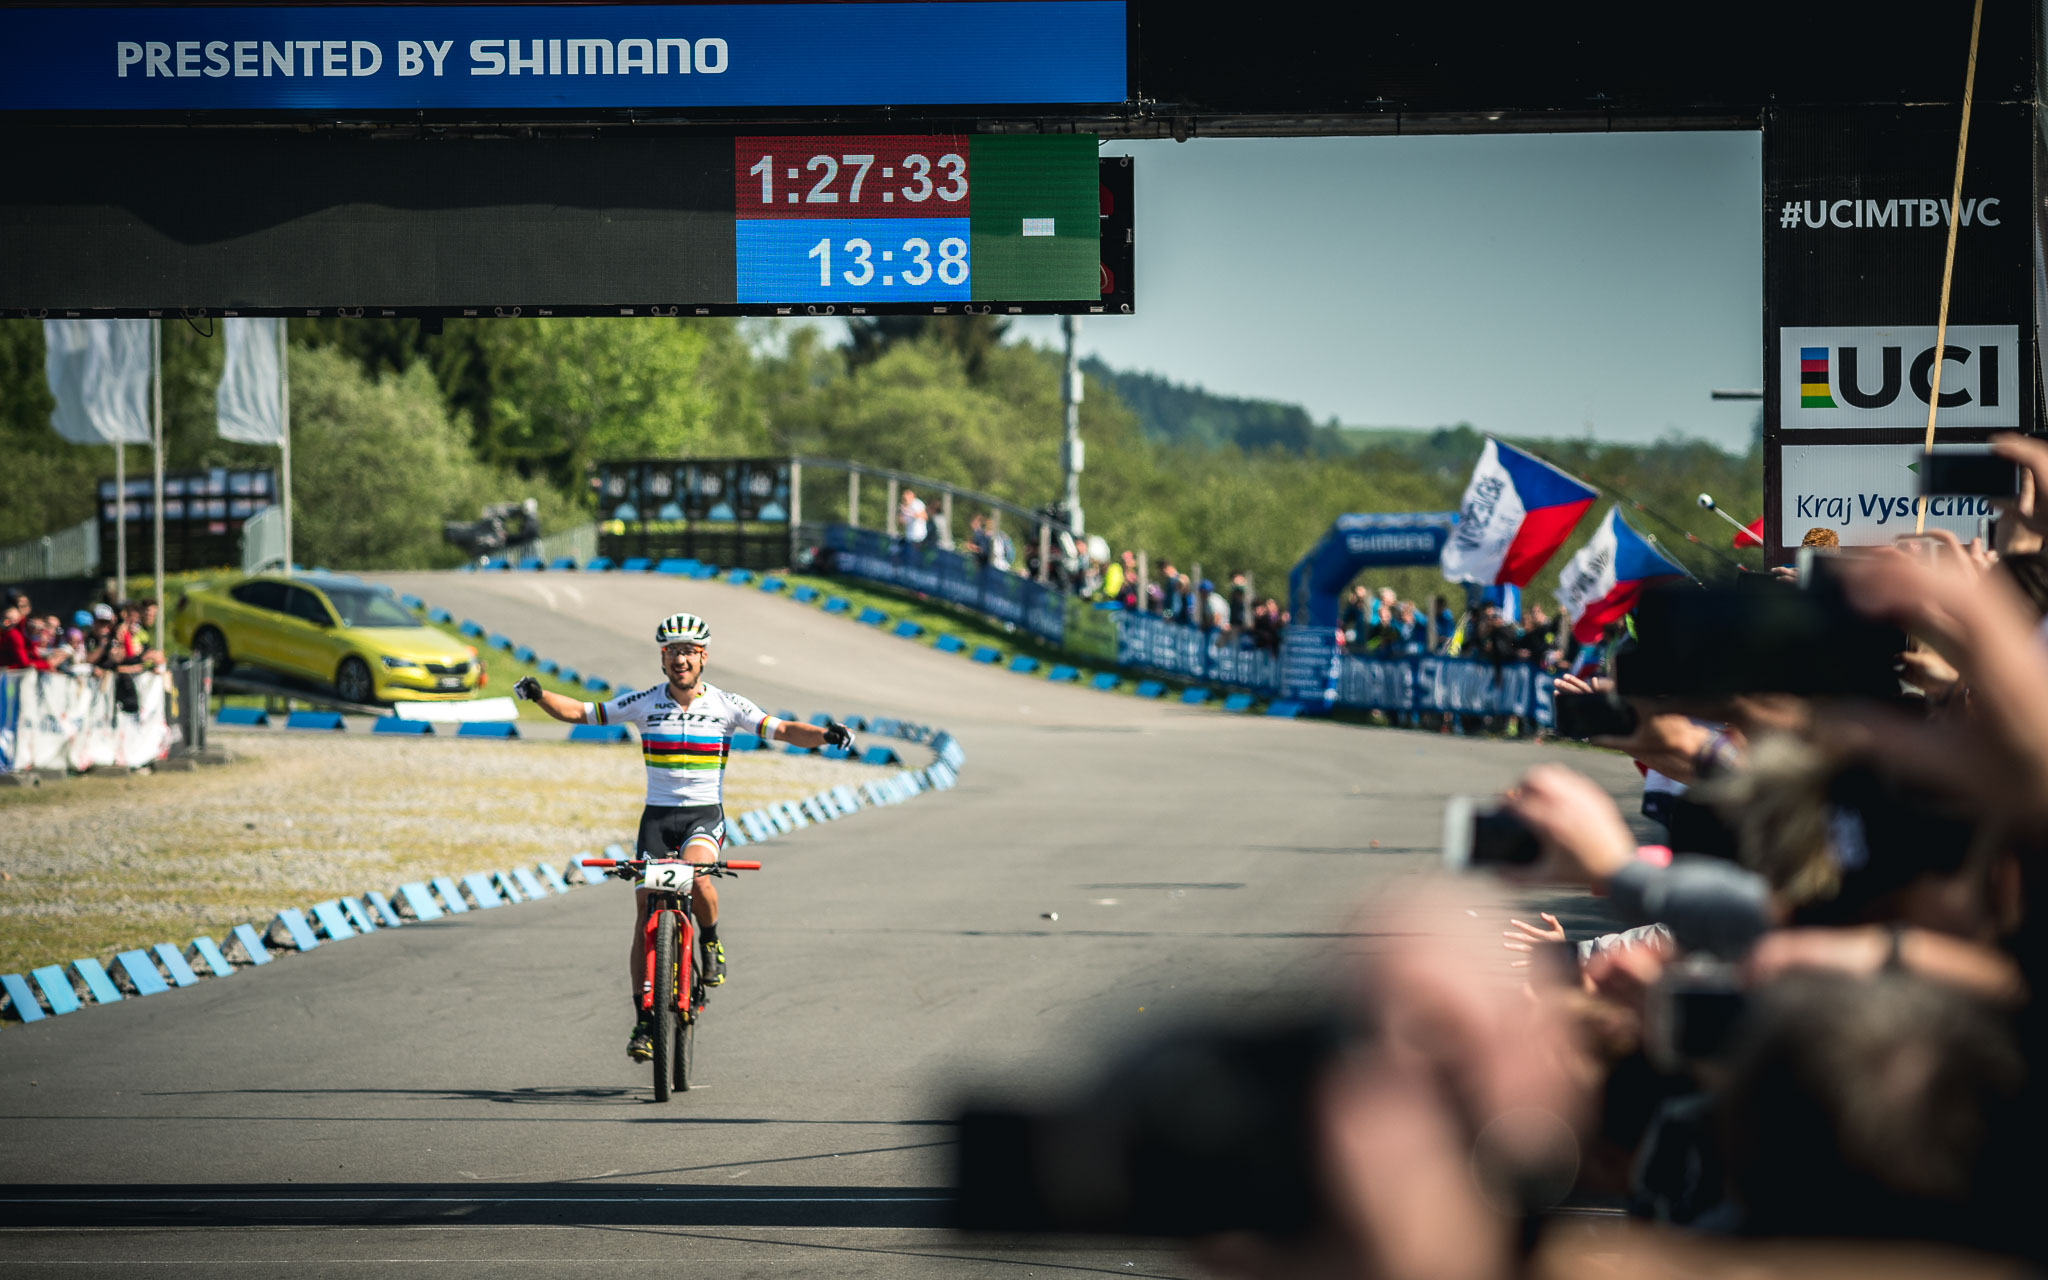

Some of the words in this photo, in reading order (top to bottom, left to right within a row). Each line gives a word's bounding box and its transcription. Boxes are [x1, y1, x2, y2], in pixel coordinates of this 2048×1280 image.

[117, 40, 382, 78] PRESENTED
[399, 40, 454, 77] BY
[470, 37, 729, 75] SHIMANO
[750, 153, 969, 203] 1:27:33
[1780, 198, 2001, 228] #UCIMTBWC
[808, 237, 970, 286] 13:38
[1838, 345, 1999, 410] UCI
[1796, 494, 1851, 525] Kraj
[662, 870, 676, 888] 2
